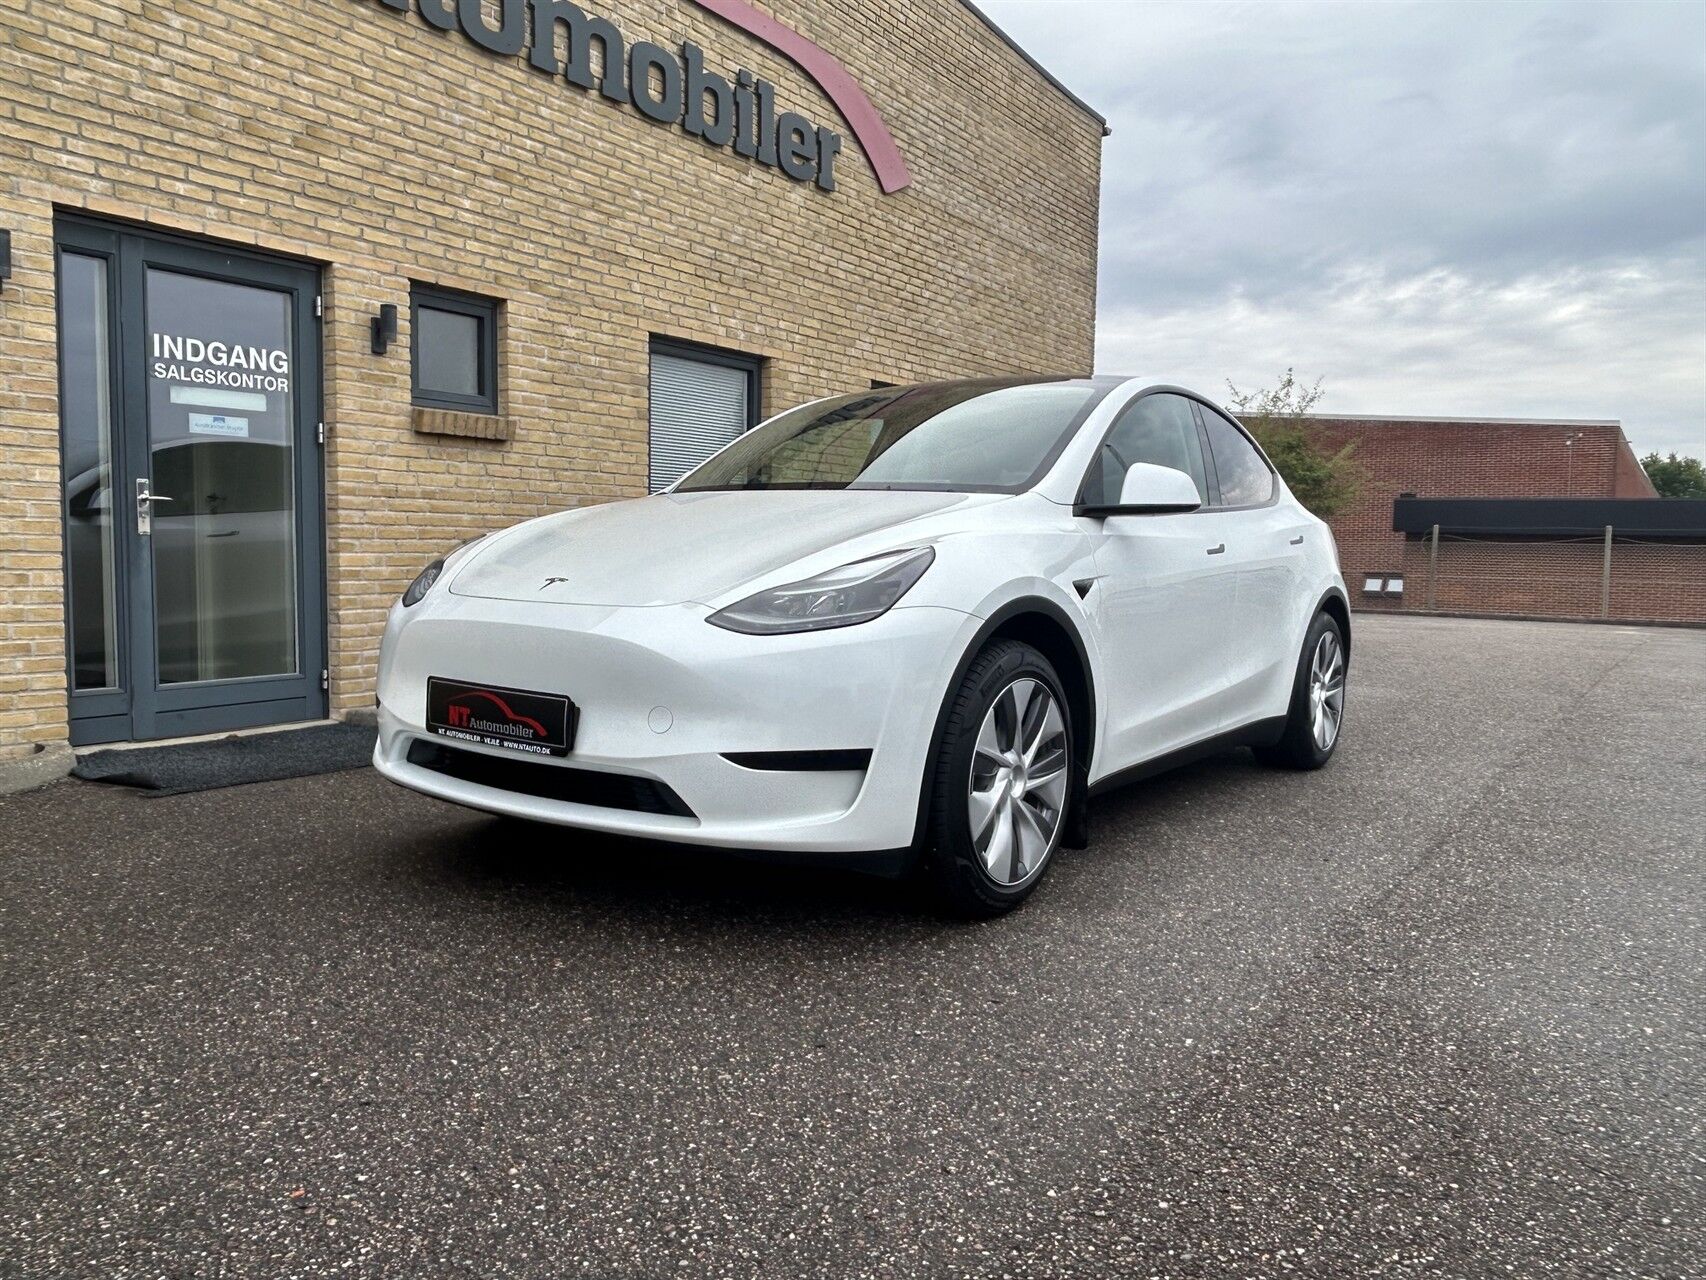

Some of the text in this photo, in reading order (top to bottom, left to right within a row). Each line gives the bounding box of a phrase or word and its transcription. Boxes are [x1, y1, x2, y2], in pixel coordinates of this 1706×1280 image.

[153, 333, 289, 374] INDGANG
[154, 362, 289, 393] SALGSKONTOR
[448, 704, 534, 738] NT Automobiler
[446, 730, 481, 742] AUTOMOBILER
[503, 740, 551, 755] WWW.NTAUTO.DK
